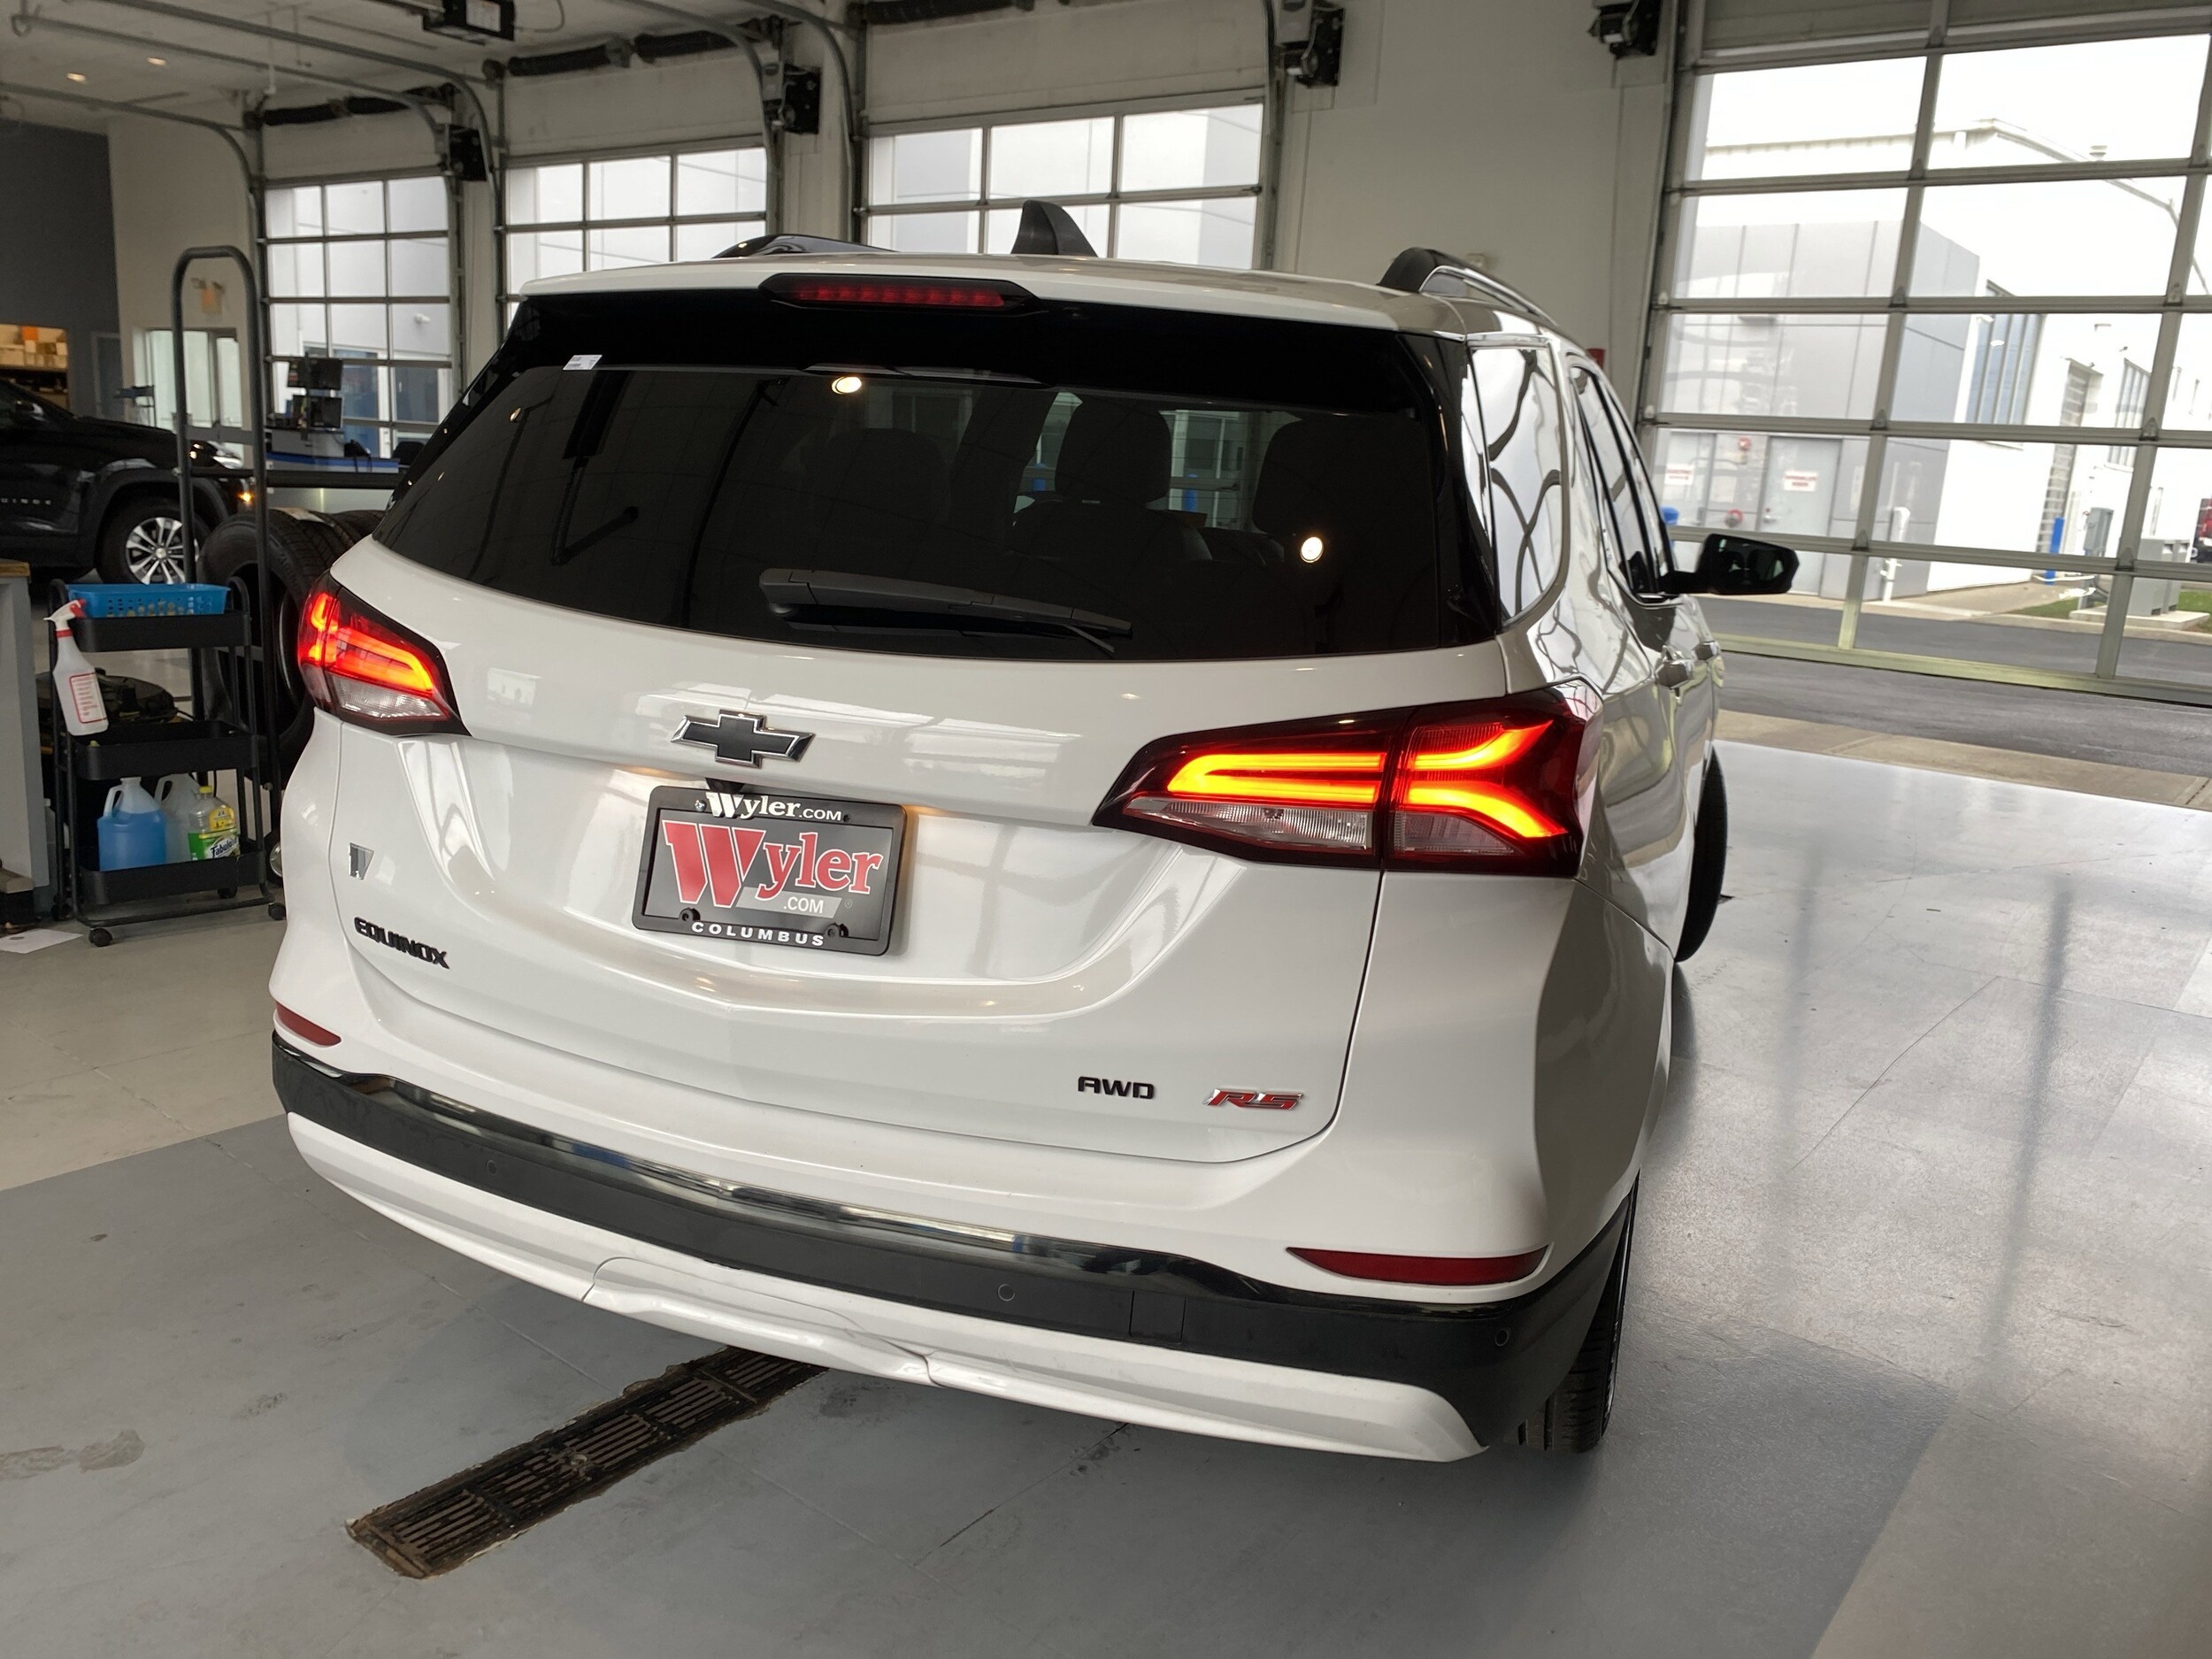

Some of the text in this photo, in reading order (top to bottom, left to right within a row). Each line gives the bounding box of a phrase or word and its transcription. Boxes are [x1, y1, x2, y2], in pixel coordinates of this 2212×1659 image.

[662, 820, 883, 908] Wyler
[783, 896, 824, 914] .COM
[354, 917, 449, 969] EQUINOX
[692, 922, 824, 947] COLUMBUS
[1078, 1076, 1154, 1099] AWD
[1202, 1088, 1303, 1110] RS
